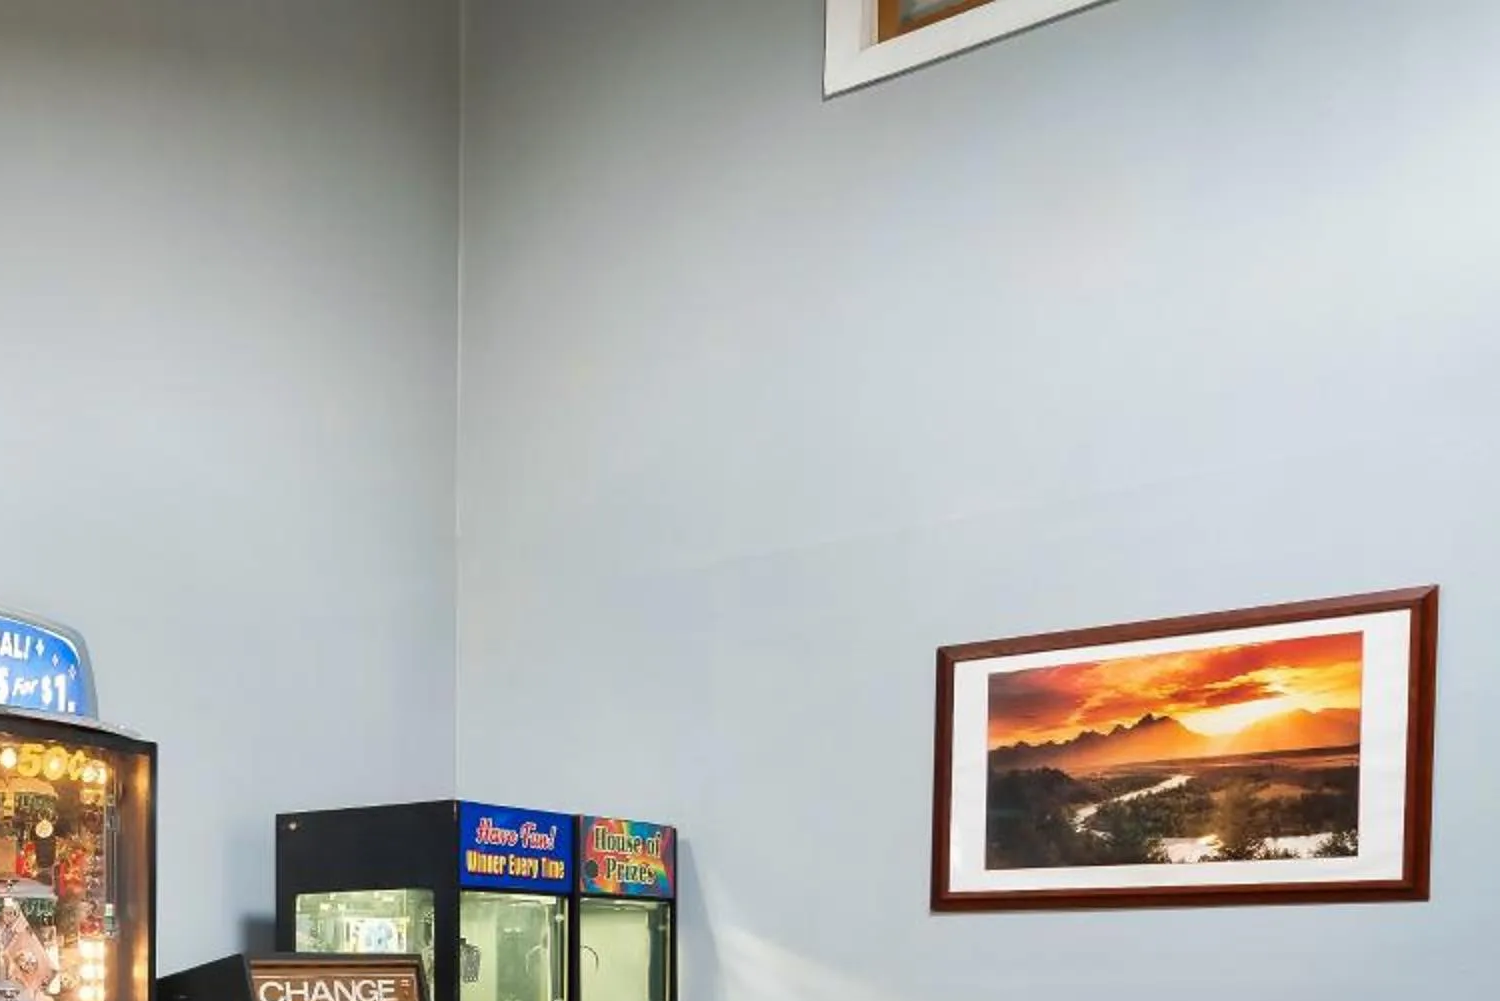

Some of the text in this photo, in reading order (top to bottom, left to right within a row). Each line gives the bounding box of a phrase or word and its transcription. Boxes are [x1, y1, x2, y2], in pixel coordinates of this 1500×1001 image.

[475, 817, 557, 851] Have Fun!
[593, 825, 661, 858] House of
[508, 853, 539, 879] Every
[604, 856, 656, 885] Prizes
